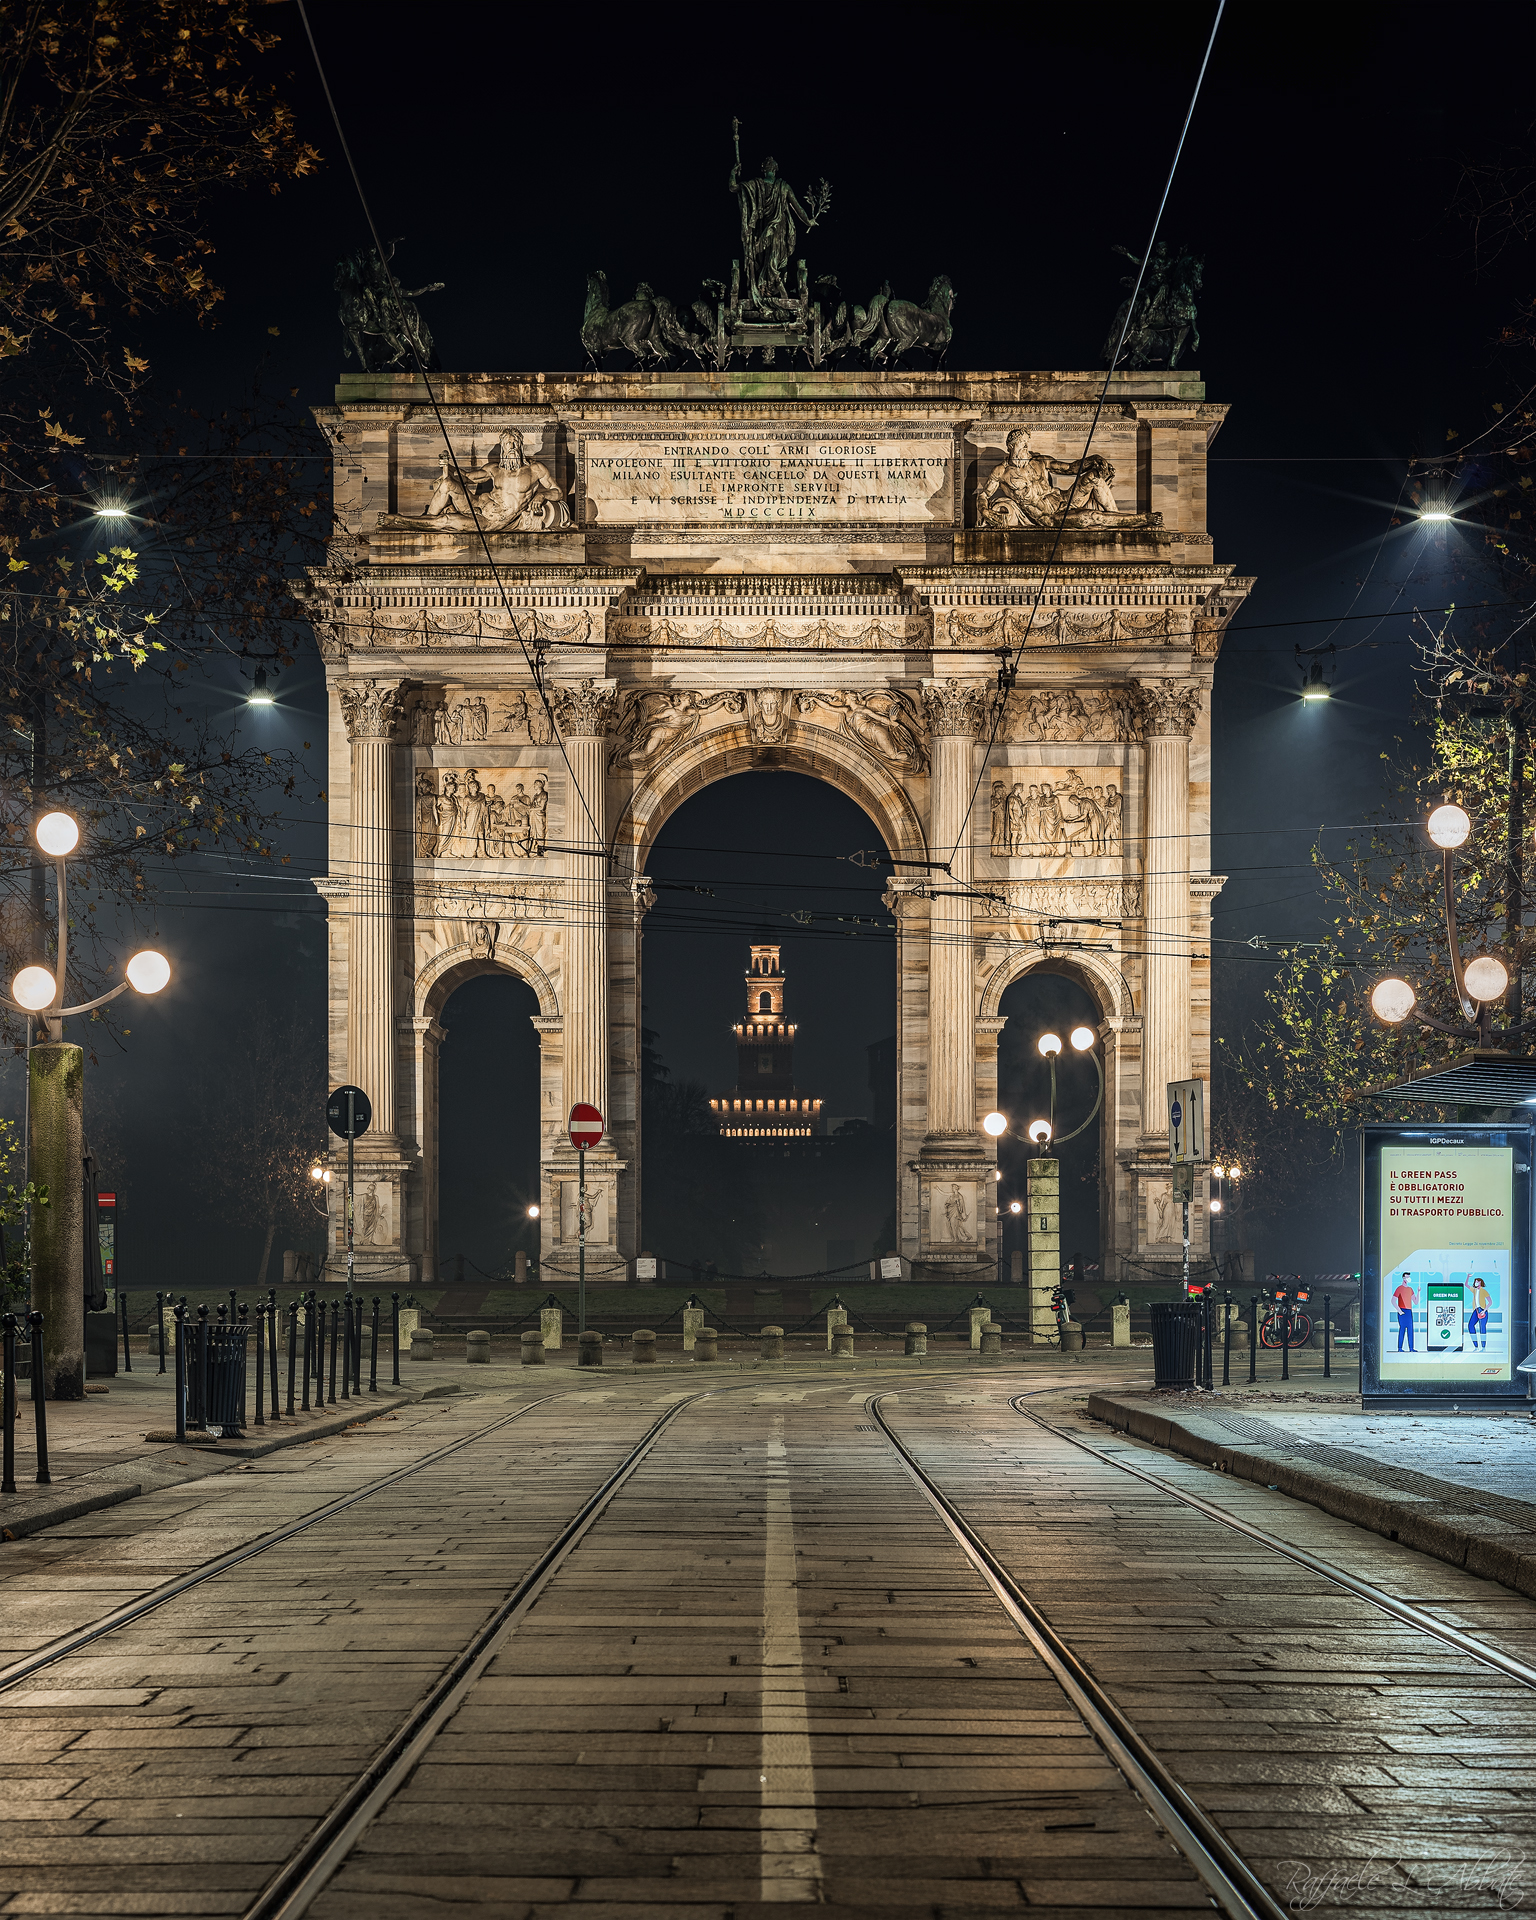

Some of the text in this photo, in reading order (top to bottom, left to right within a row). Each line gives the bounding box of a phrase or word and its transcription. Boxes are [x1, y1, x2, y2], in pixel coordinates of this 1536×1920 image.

[664, 446, 729, 456] ENTRANDO
[780, 446, 809, 455] ARMI
[819, 446, 877, 455] GLORIOSE
[591, 458, 948, 468] NAPOLEONE III E VITTORIO EMANUELE II LIBERATORI
[612, 471, 661, 480] MILANO
[670, 471, 736, 480] ESULTANTE
[813, 471, 828, 480] DA
[837, 471, 879, 480] QUESTI
[887, 471, 927, 480] MARMI
[699, 483, 840, 492] LE IMPRONTE SERVILI
[631, 496, 638, 505] E
[649, 496, 661, 505] VI
[670, 496, 717, 505] SCRISSE
[743, 496, 837, 505] INDIPENDENZA
[866, 495, 907, 504] ITALIA
[1390, 1171, 1458, 1179] IL GREEN PASS
[1390, 1181, 1465, 1191] È OBBLIGATORIO
[1390, 1196, 1464, 1204] SU TUTTI I MEZZI
[1390, 1209, 1504, 1217] DI TRASPORTO PUBBLICO.
